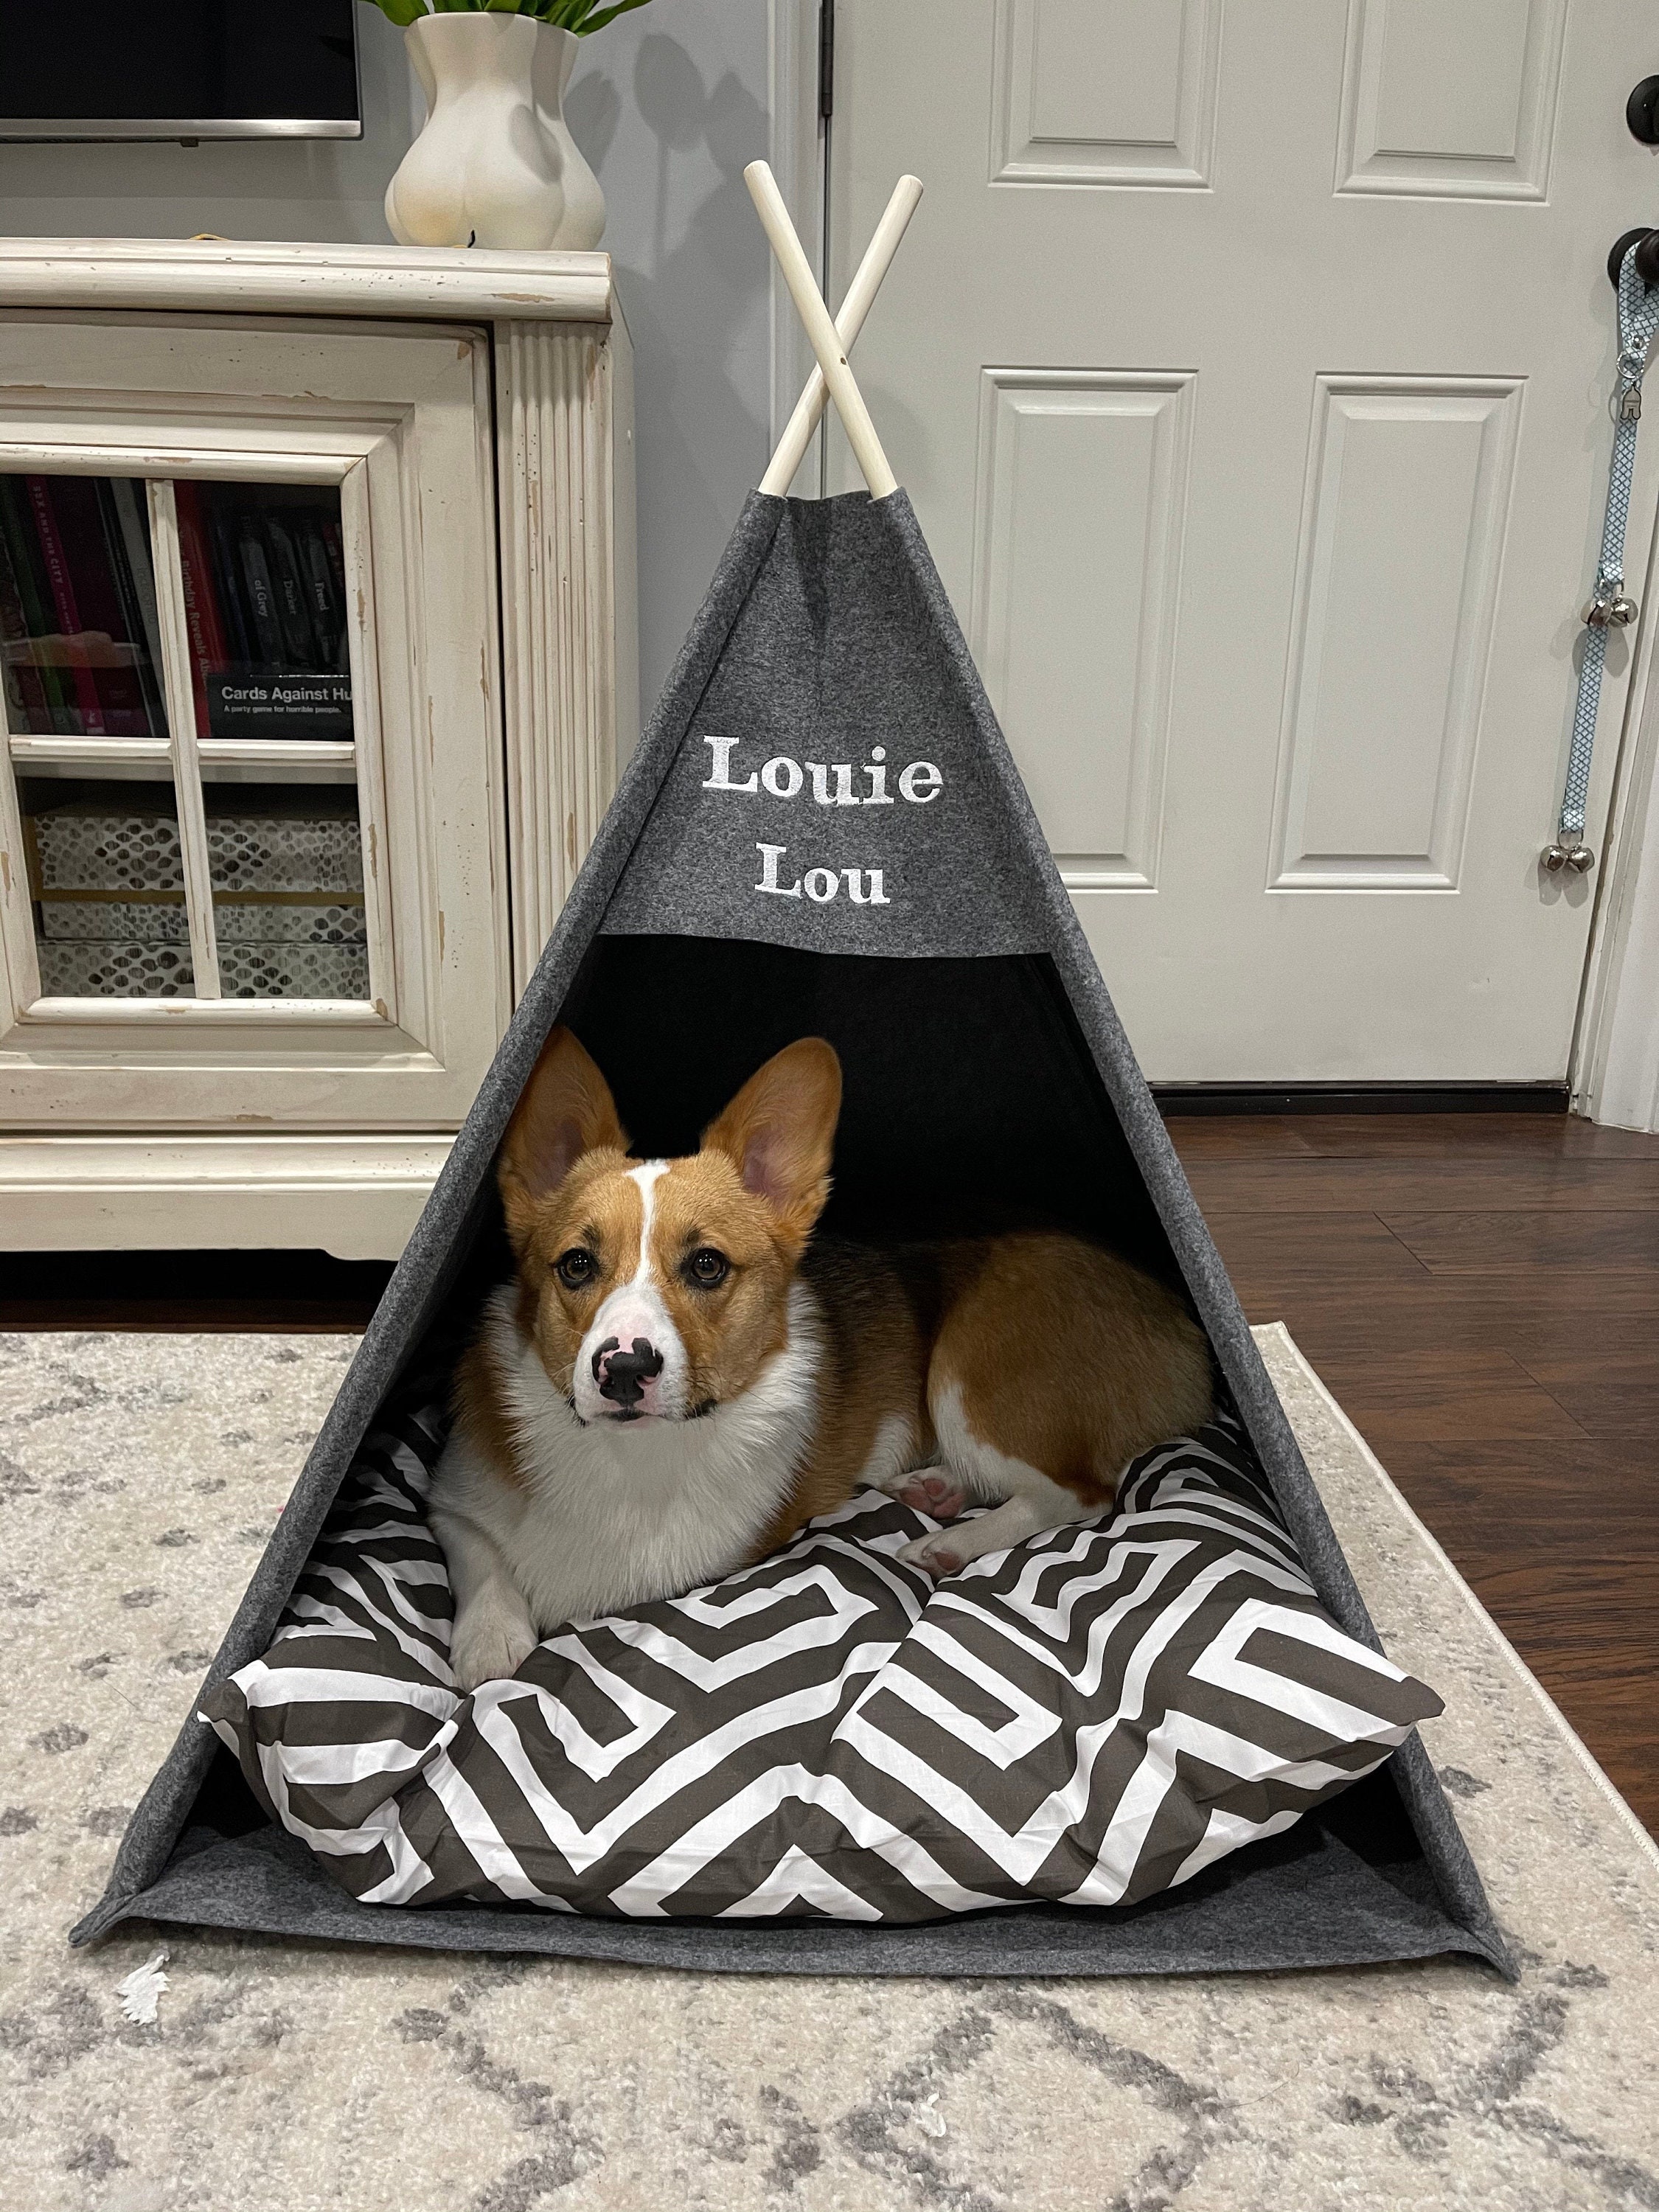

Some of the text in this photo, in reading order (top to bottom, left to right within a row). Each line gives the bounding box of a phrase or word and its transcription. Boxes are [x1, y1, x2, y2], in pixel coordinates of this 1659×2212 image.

[50, 558, 63, 584] CITY
[182, 560, 196, 609] Birthday
[189, 612, 207, 655] Reveals
[254, 579, 268, 616] of Grey
[283, 579, 296, 615] Darker
[315, 582, 330, 611] Freed
[221, 686, 268, 700] Cards
[271, 686, 329, 703] Against
[231, 706, 251, 714] party
[703, 735, 944, 806] Louie
[755, 841, 891, 904] Lou
